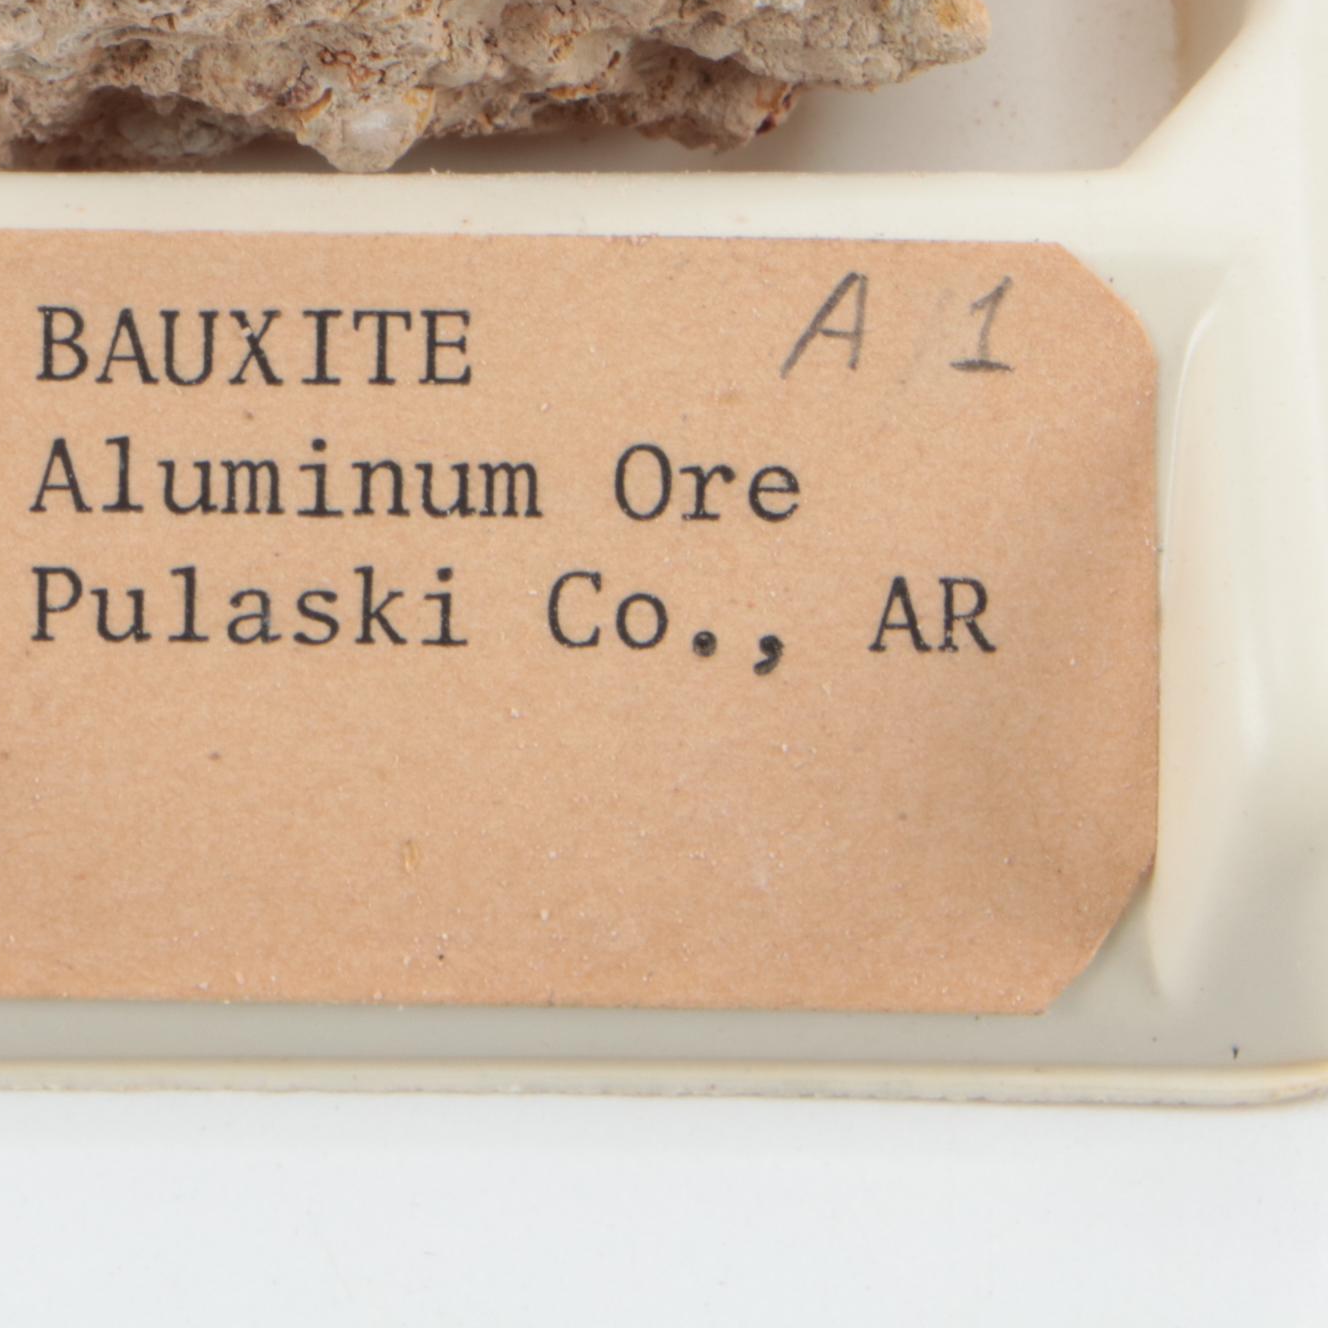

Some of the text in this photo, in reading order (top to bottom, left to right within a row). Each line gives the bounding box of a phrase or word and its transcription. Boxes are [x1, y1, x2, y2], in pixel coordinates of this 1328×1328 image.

[34, 304, 474, 389] BAUXITE
[781, 270, 1014, 378] A 1
[27, 434, 802, 525] Aluminum Ore
[29, 564, 999, 678] Pulaski Co., AR
